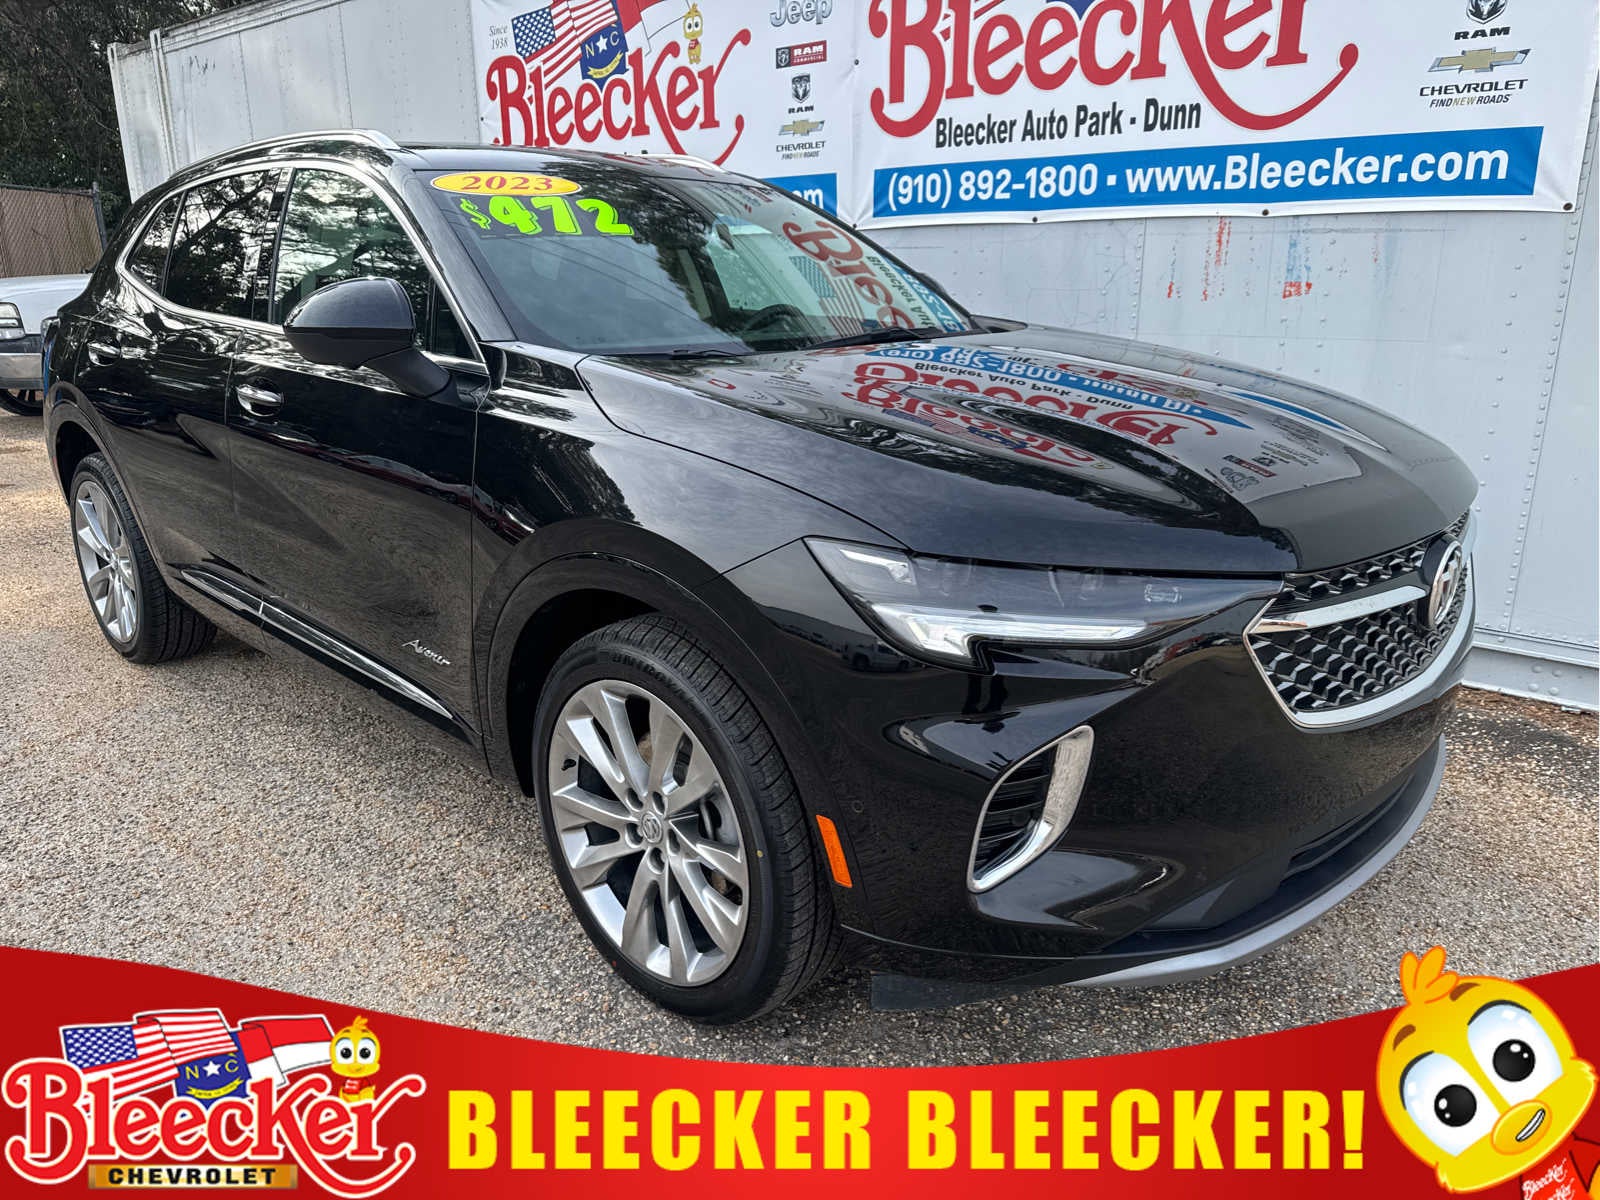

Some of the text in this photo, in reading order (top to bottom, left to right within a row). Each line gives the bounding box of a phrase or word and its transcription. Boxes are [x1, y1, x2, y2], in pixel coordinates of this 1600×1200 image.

[769, 0, 833, 27] Jeep
[489, 25, 508, 37] Since
[1454, 26, 1511, 41] RAM
[491, 38, 508, 50] 1938
[793, 44, 824, 57] RAM
[868, 0, 1359, 138] Bleecker
[1419, 78, 1529, 97] CHEVROLET
[485, 28, 752, 166] Bleecker
[788, 105, 815, 114] RAM
[935, 98, 1202, 149] Bleecker Auto Park Dunn
[775, 140, 827, 152] CHEVROLET
[461, 175, 553, 191] 2023
[887, 147, 1510, 211] (910) 892-1800 www.Bleecker.com
